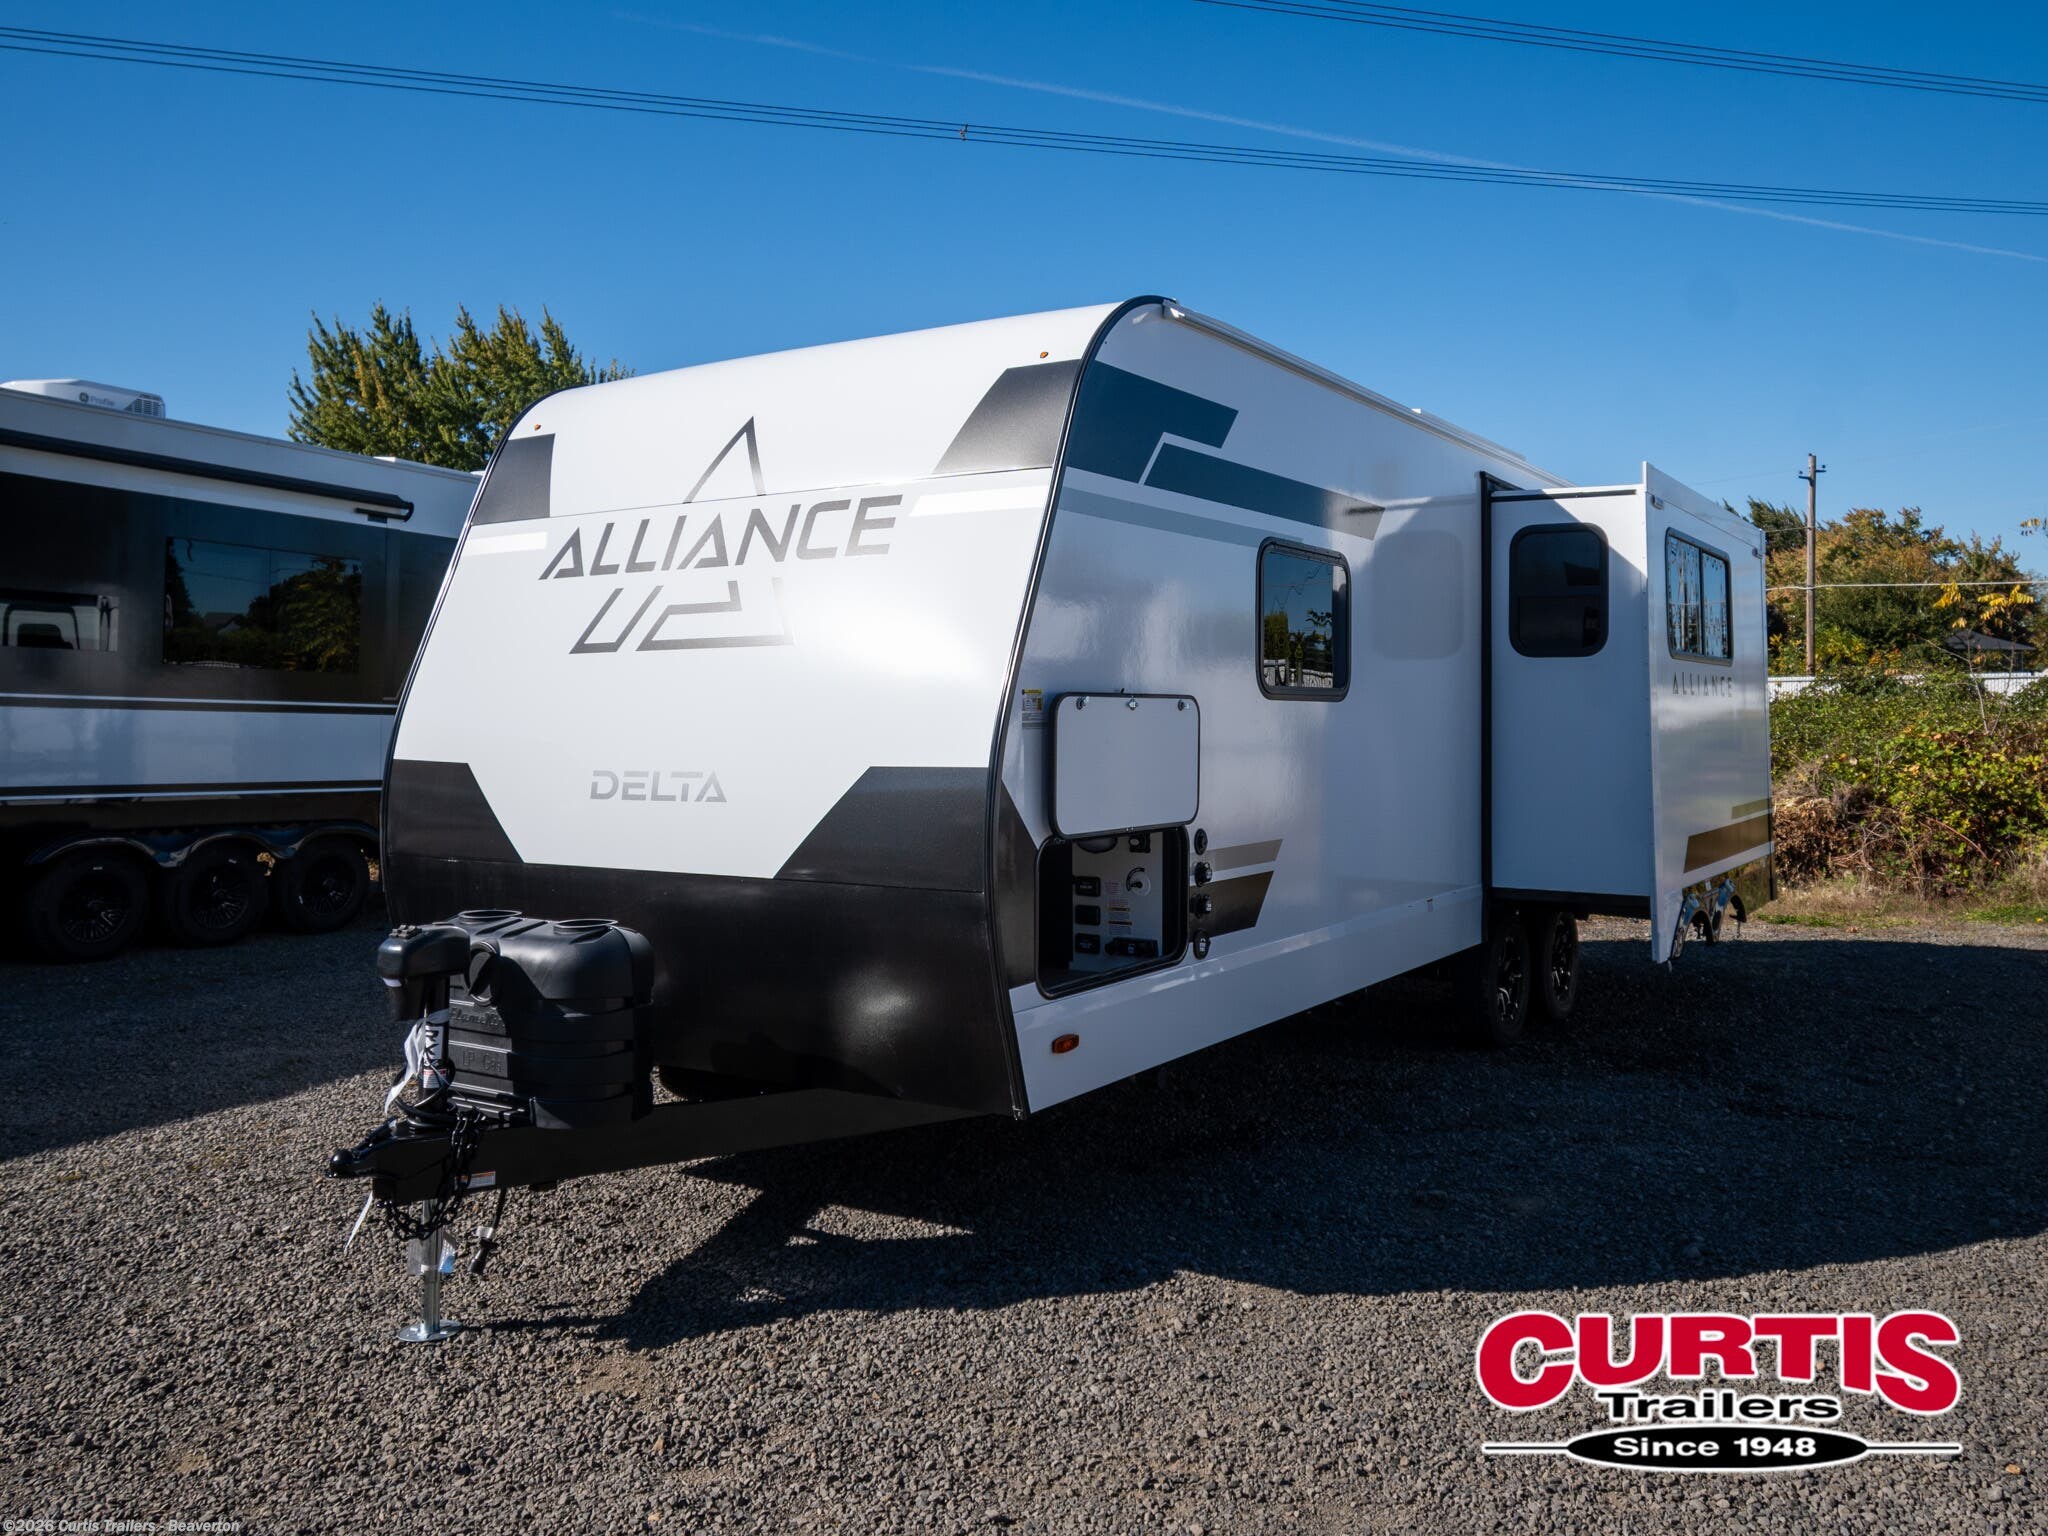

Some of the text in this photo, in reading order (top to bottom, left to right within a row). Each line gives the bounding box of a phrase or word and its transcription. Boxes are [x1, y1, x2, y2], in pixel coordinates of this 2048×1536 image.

[538, 494, 903, 581] ALLIANCE
[1672, 671, 1733, 698] ALLIANCE
[589, 769, 728, 803] DELTA
